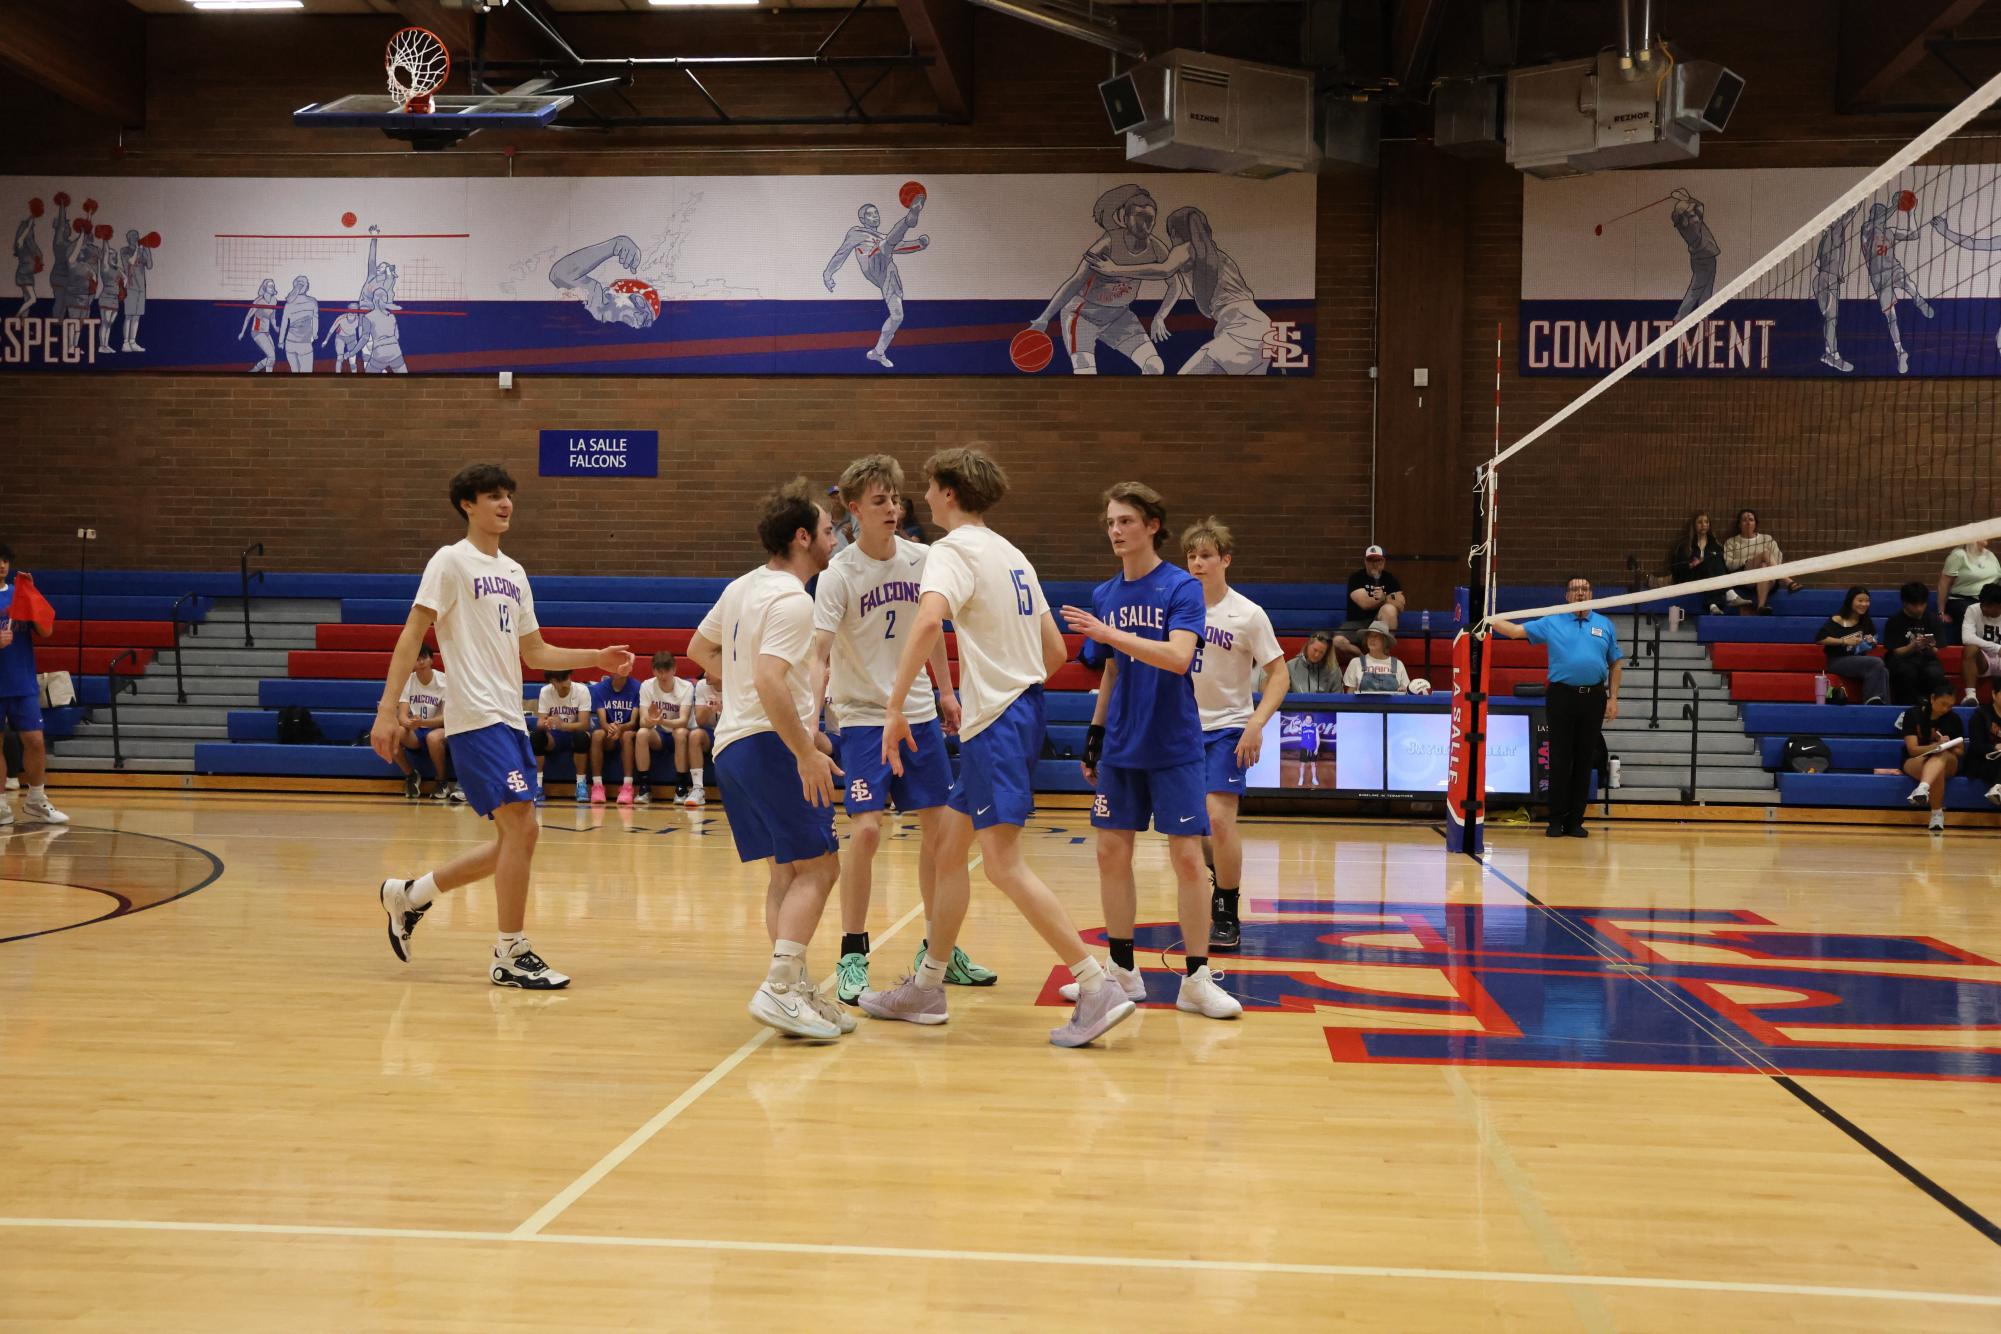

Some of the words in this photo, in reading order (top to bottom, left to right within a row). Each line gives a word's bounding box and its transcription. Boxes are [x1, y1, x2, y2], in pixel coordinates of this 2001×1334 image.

[0, 317, 101, 363] SPECT
[1528, 319, 1776, 369] COMMITMENT
[569, 438, 586, 451] LA
[589, 438, 627, 452] SALLE
[569, 454, 627, 468] FALCONS
[1009, 568, 1033, 615] 15
[498, 603, 511, 633] 12
[884, 610, 896, 640] 2
[1119, 605, 1163, 629] SALLE
[1452, 667, 1461, 696] LA
[410, 695, 439, 706] FALCONS
[1448, 706, 1461, 785] SALLE
